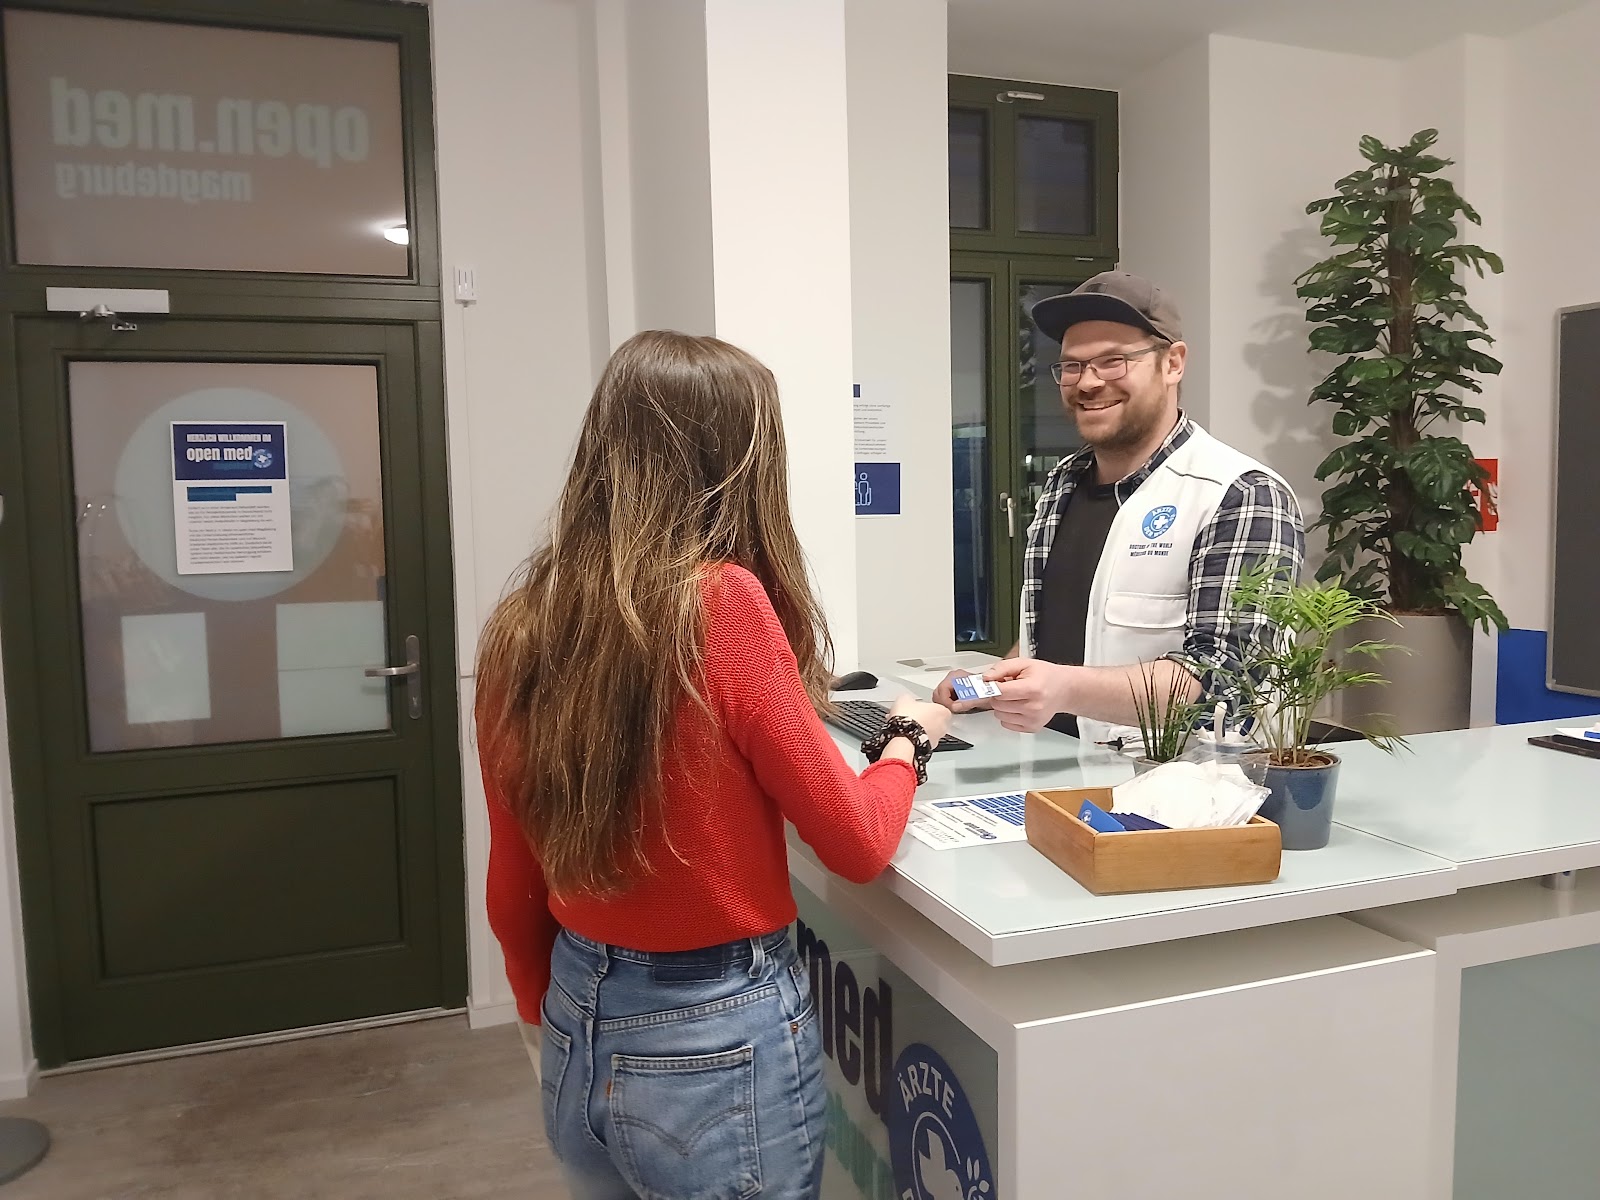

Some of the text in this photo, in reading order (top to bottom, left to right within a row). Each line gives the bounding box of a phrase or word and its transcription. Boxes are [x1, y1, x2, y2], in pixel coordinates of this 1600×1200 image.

[187, 447, 220, 462] open
[223, 446, 252, 460] med
[896, 1061, 956, 1120] ÄRZTE
